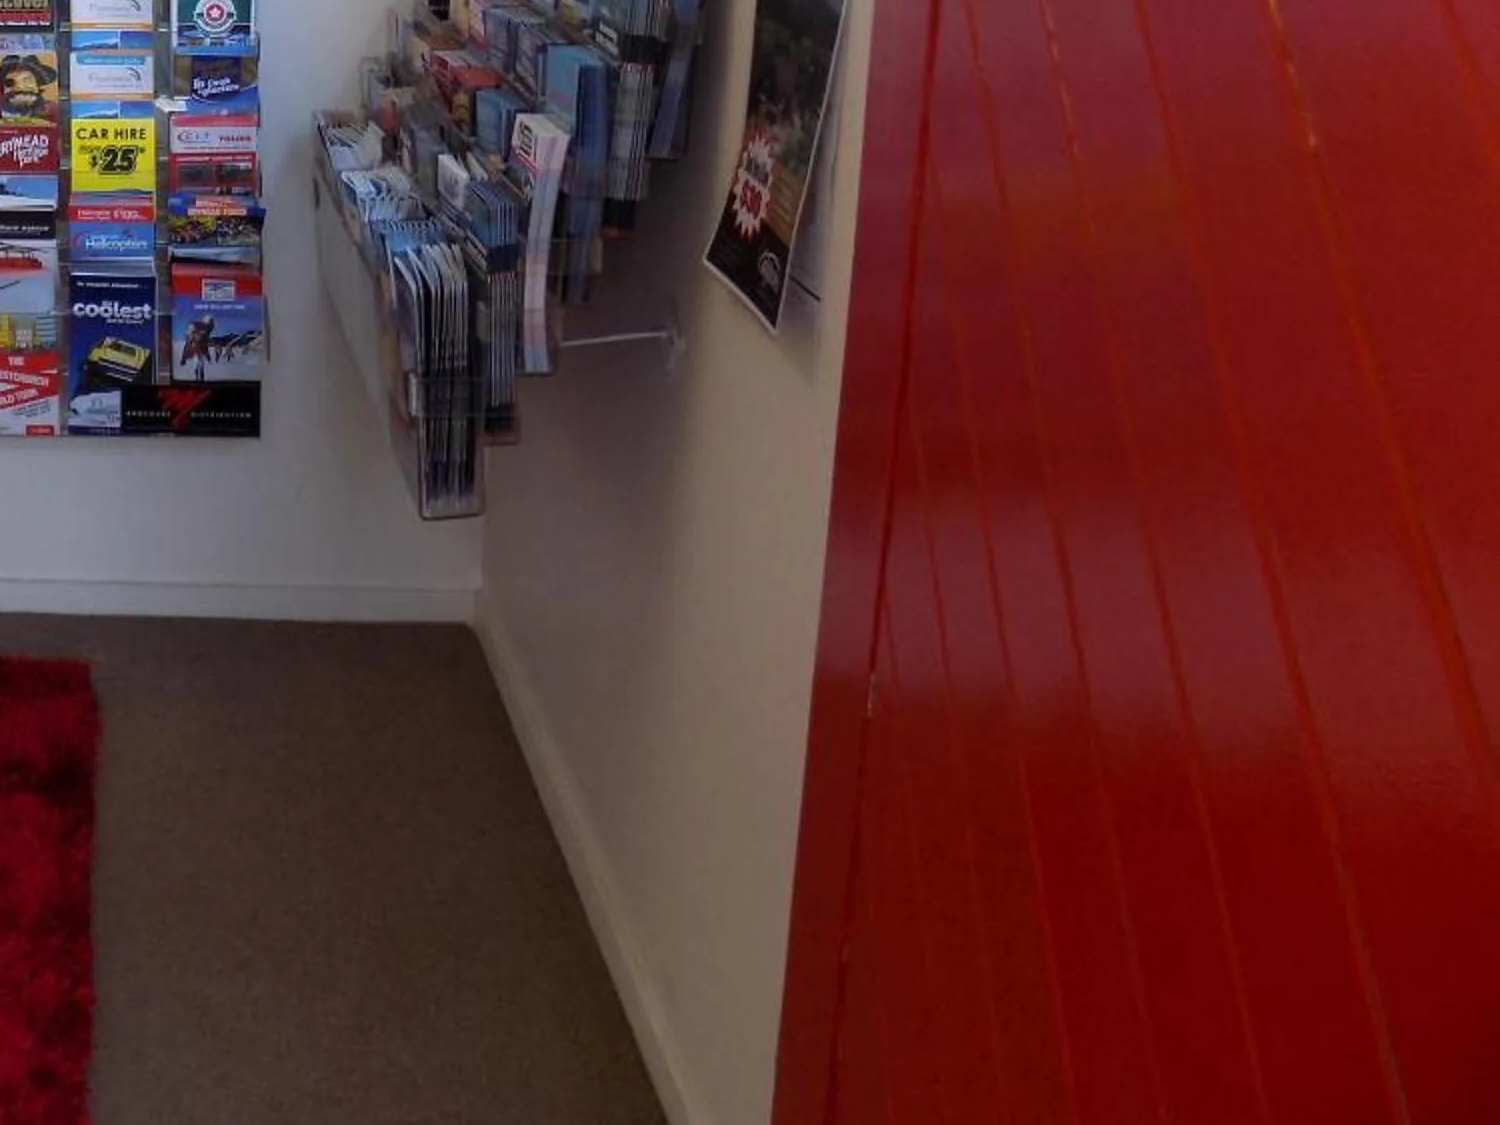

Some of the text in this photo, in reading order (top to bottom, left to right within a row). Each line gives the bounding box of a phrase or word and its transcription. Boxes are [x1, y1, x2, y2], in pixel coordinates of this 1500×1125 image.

[75, 128, 148, 140] CAR HIRE
[190, 411, 253, 419] DISTRIBUTION
